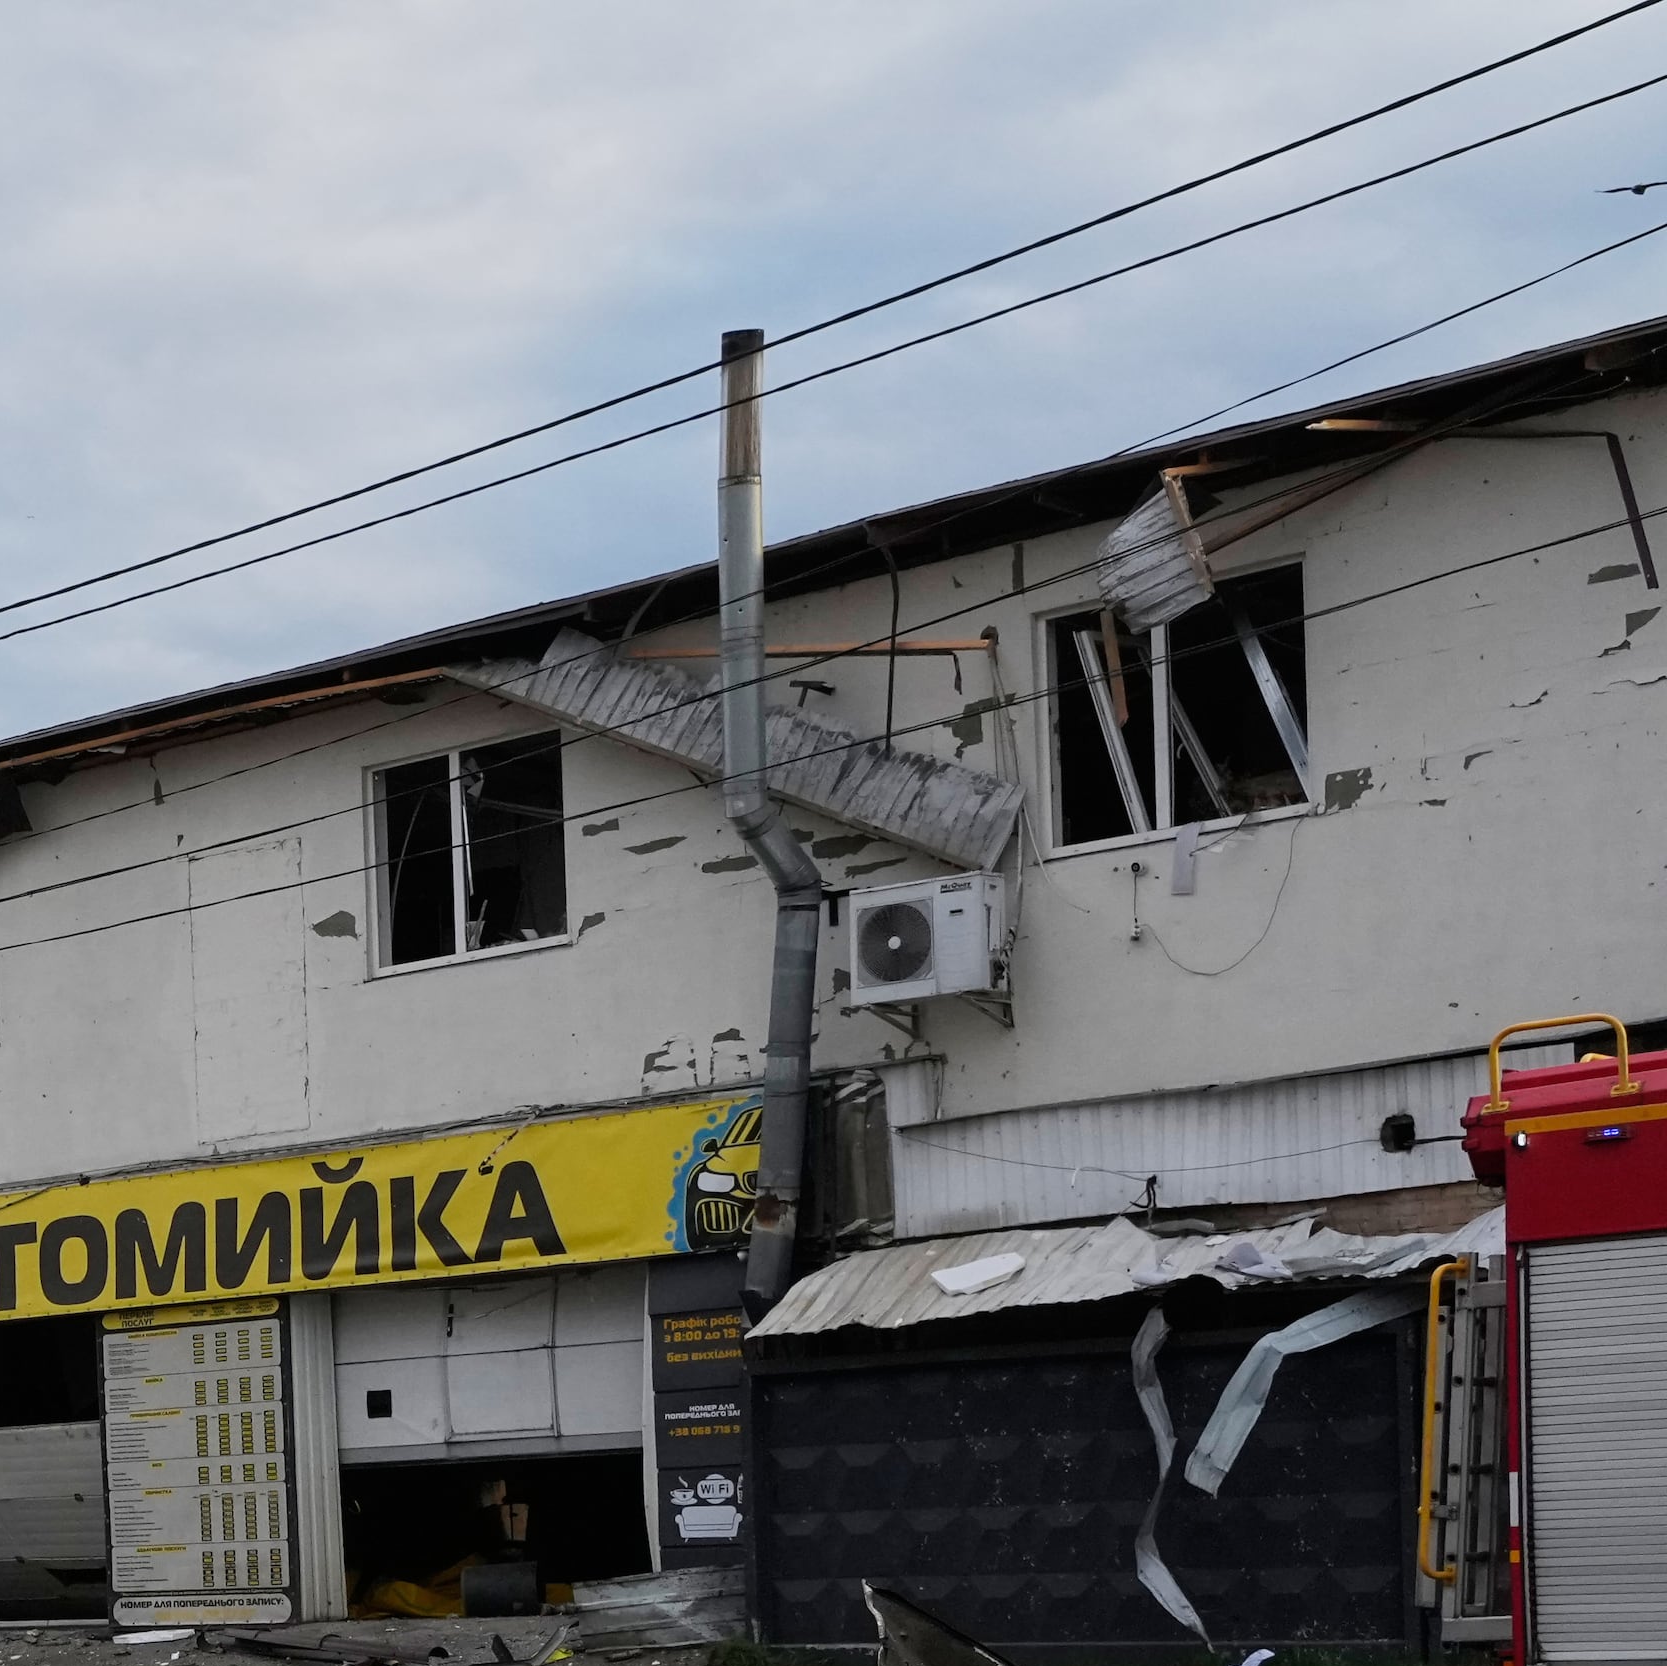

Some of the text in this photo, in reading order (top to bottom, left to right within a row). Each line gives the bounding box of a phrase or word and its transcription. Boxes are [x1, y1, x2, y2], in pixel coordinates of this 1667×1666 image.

[663, 1317, 707, 1331] Графік
[674, 1331, 702, 1342] 8:00
[704, 1332, 721, 1340] до
[689, 1403, 735, 1412] НОМЕР ДЛЯ
[665, 1409, 727, 1420] ПОПЕРЕДНЬОГО
[120, 1597, 284, 1609] НОМЕР ДЛЯ ПОПЕРЕДНЬОГО ЗАПИСУ:
